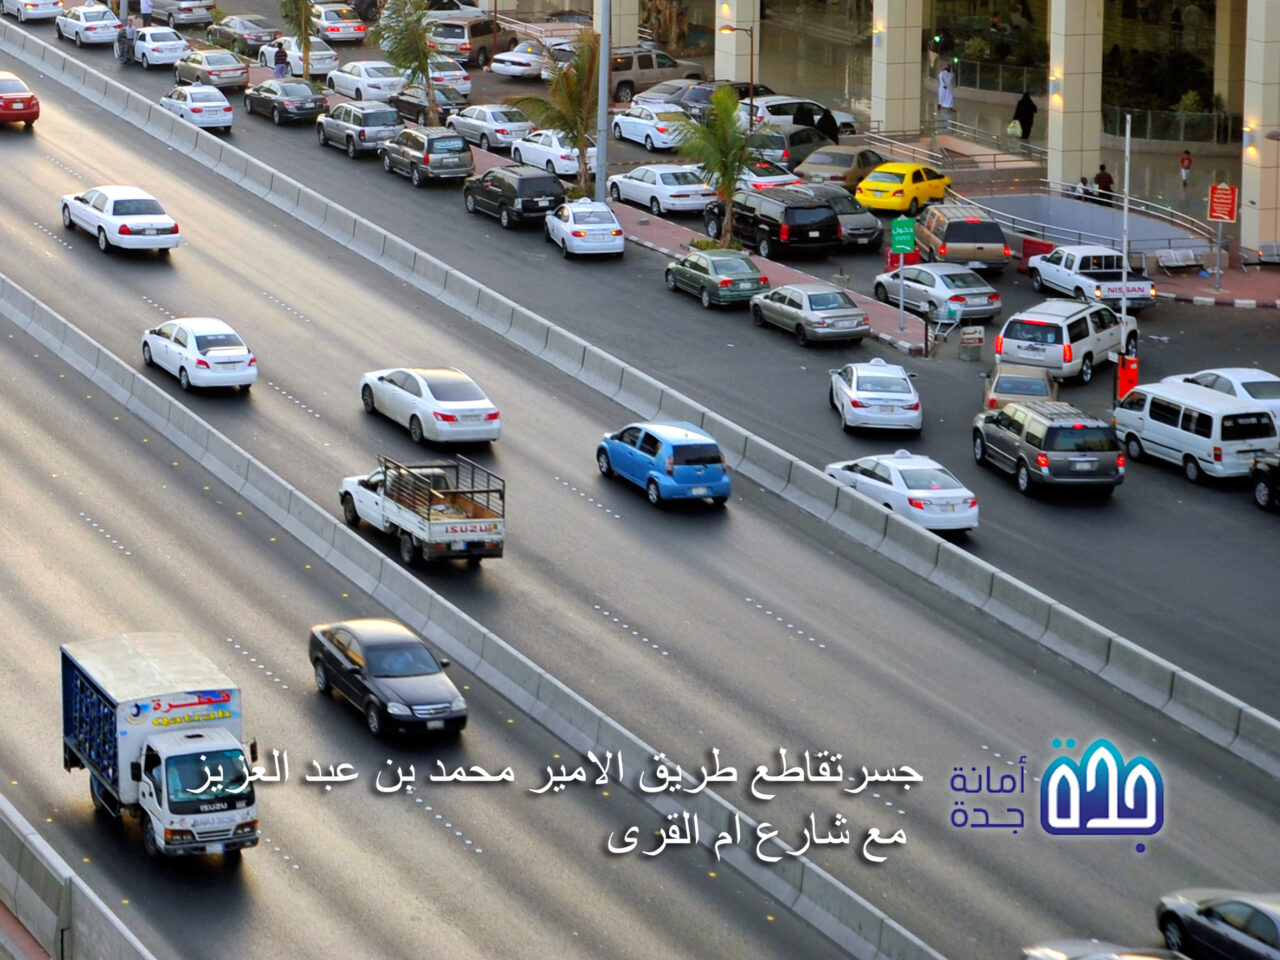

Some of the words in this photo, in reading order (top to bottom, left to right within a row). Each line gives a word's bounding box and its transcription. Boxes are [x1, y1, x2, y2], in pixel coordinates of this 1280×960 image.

[445, 525, 488, 534] ISUZU
[152, 689, 232, 713] قطرة
[152, 709, 232, 727] Qatrah
[199, 802, 228, 812] ISUZU
